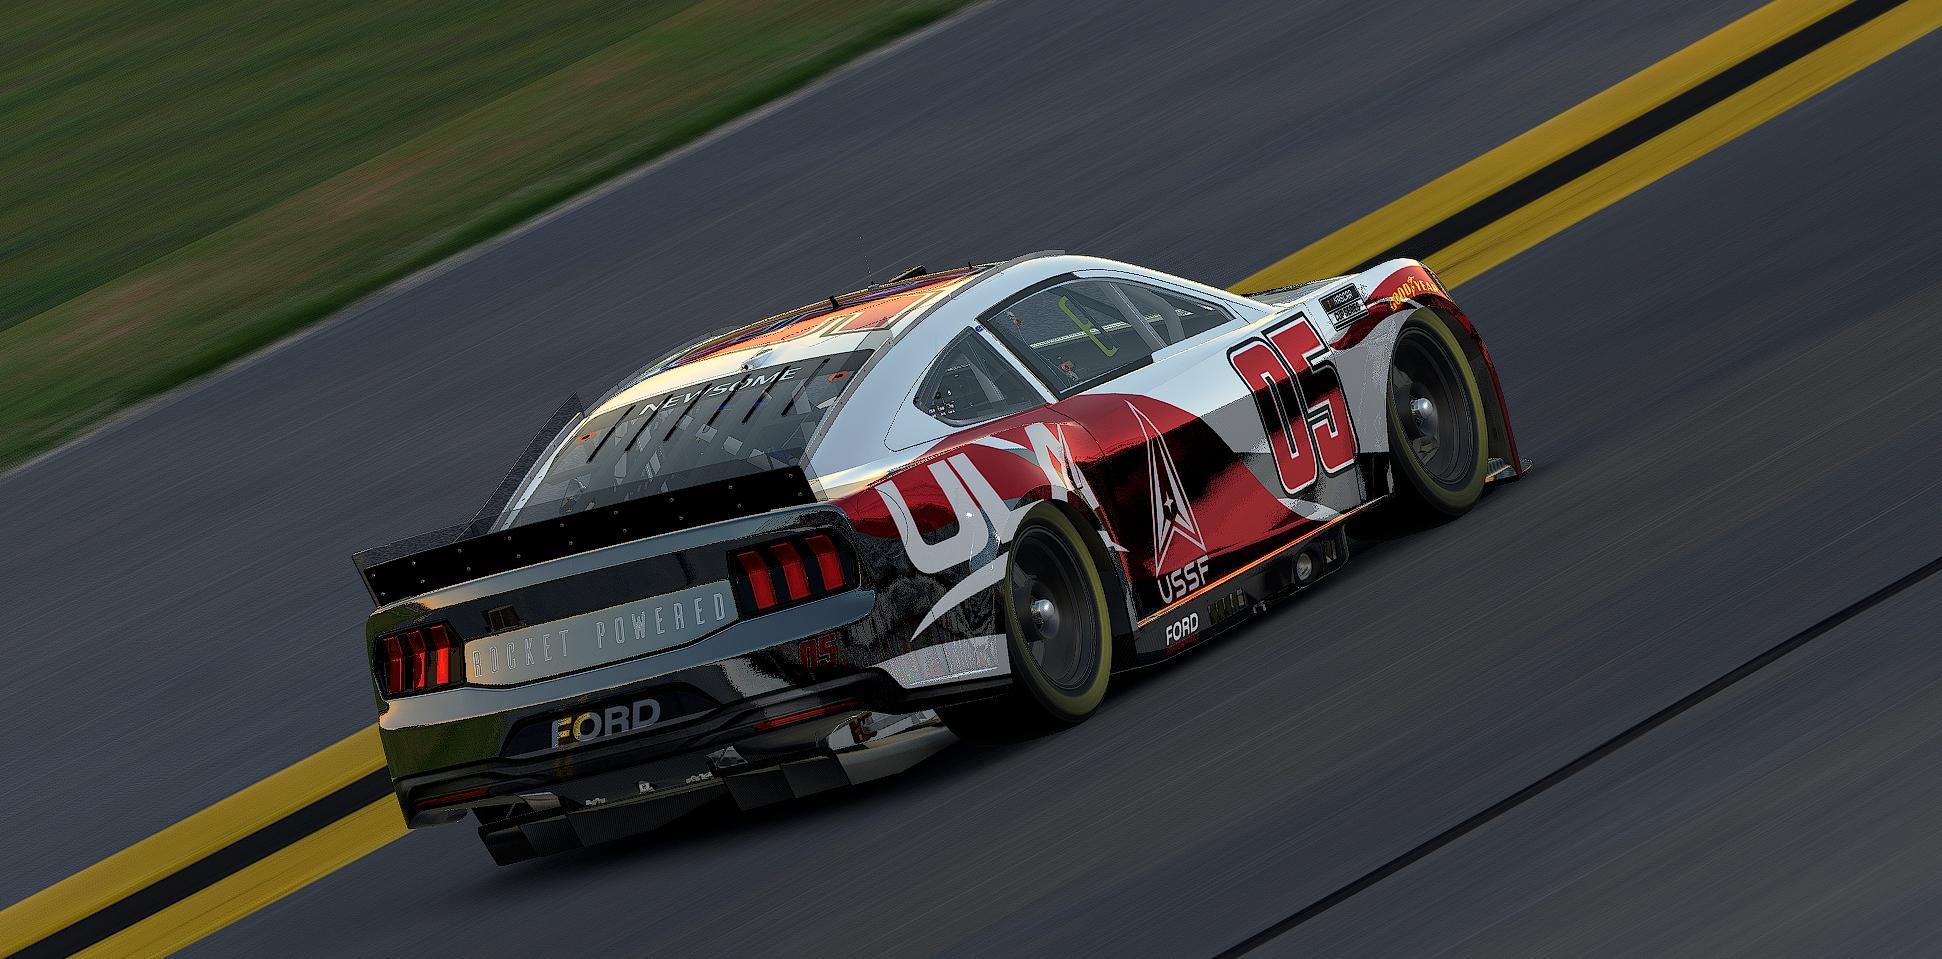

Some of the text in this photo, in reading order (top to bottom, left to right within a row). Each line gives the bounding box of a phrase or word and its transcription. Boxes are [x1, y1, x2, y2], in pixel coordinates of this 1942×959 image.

[1390, 276, 1441, 311] GOODYEAR
[638, 368, 801, 416] NEWSOME
[1226, 312, 1361, 499] 05
[1157, 555, 1209, 604] USSF
[472, 592, 726, 678] ROCKET POWERED
[1165, 612, 1199, 646] FORD
[551, 698, 661, 750] FORD
